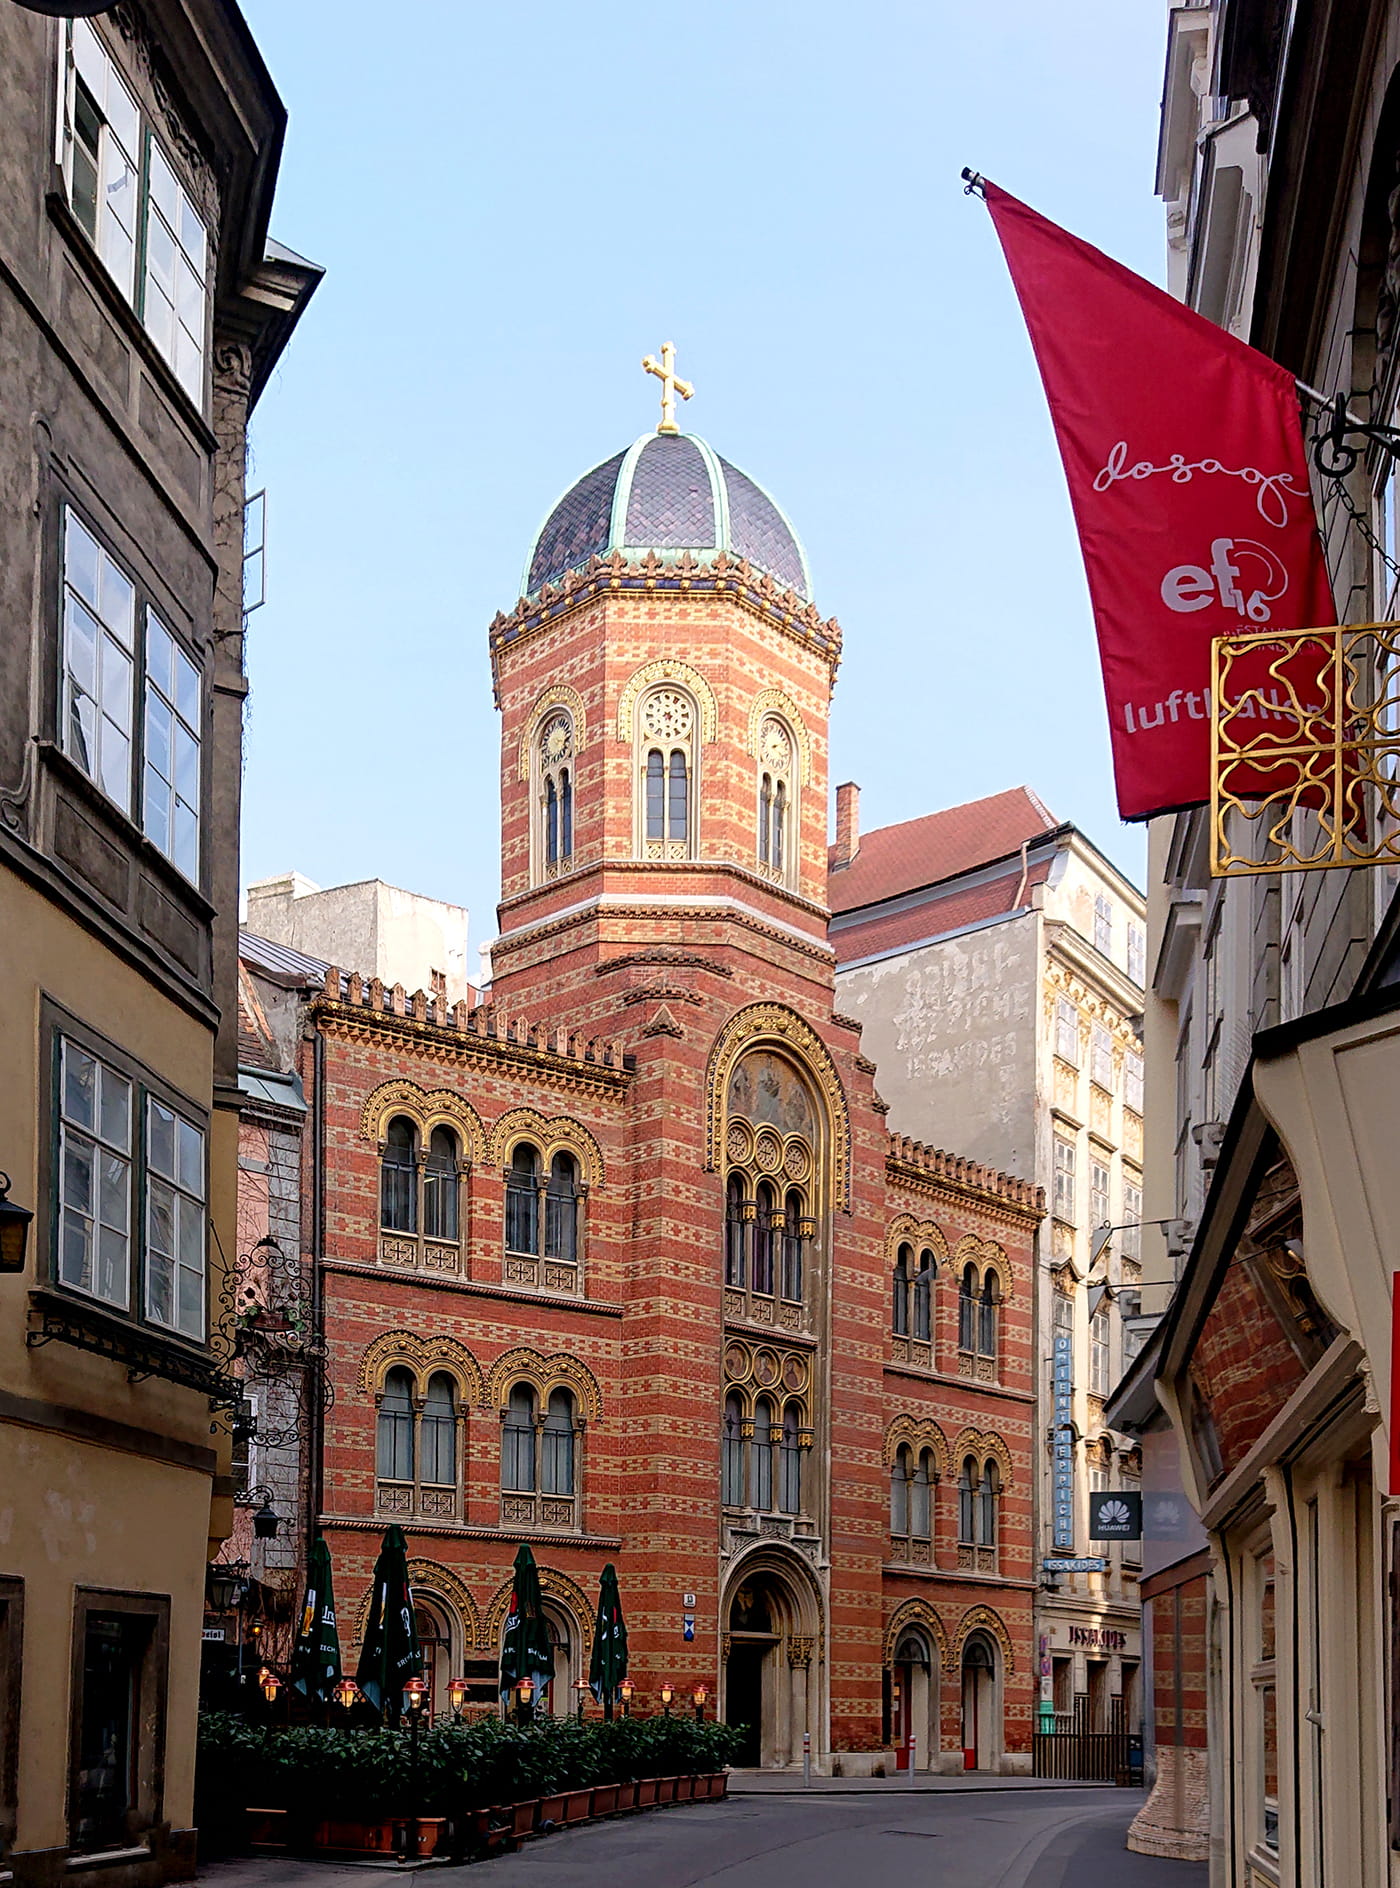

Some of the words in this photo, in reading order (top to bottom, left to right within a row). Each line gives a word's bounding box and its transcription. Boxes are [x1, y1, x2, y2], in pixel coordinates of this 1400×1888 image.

[1098, 1524, 1131, 1532] HUAWEI
[1047, 1560, 1100, 1571] ISSAKIDES
[1068, 1626, 1127, 1649] ISSAKIDES
